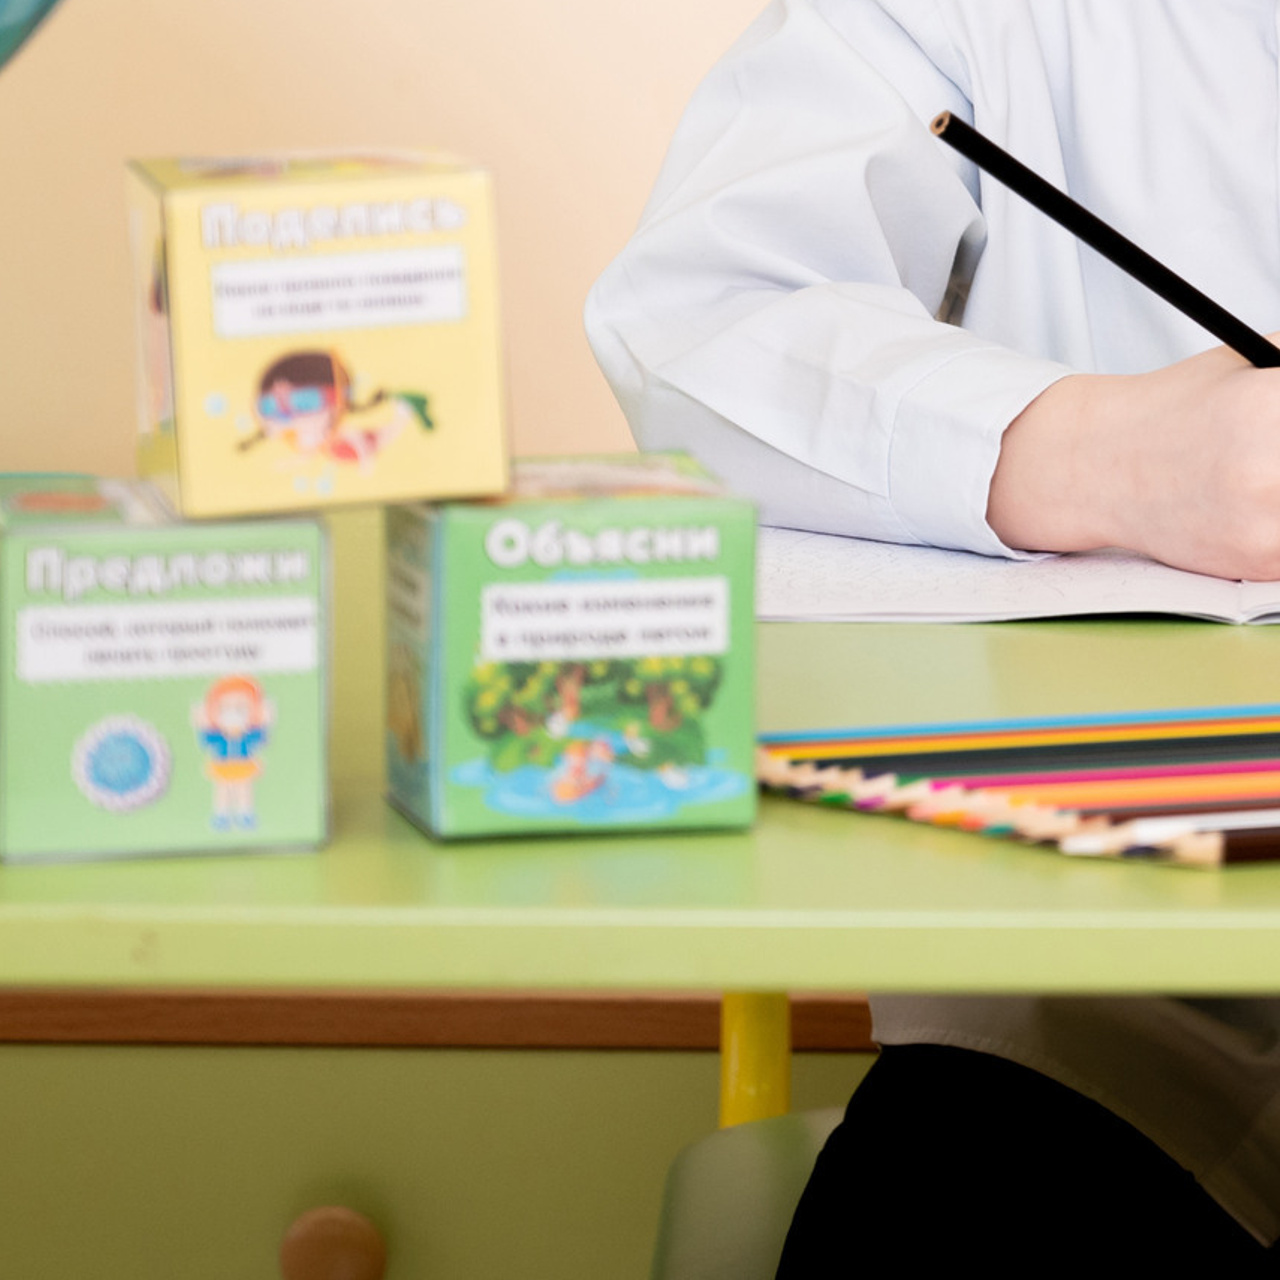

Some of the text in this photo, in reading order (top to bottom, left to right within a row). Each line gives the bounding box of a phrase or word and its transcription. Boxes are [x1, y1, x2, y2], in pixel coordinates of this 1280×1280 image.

[200, 197, 469, 253] Поделись
[484, 517, 722, 569] Объясни
[25, 546, 309, 602] Предложи
